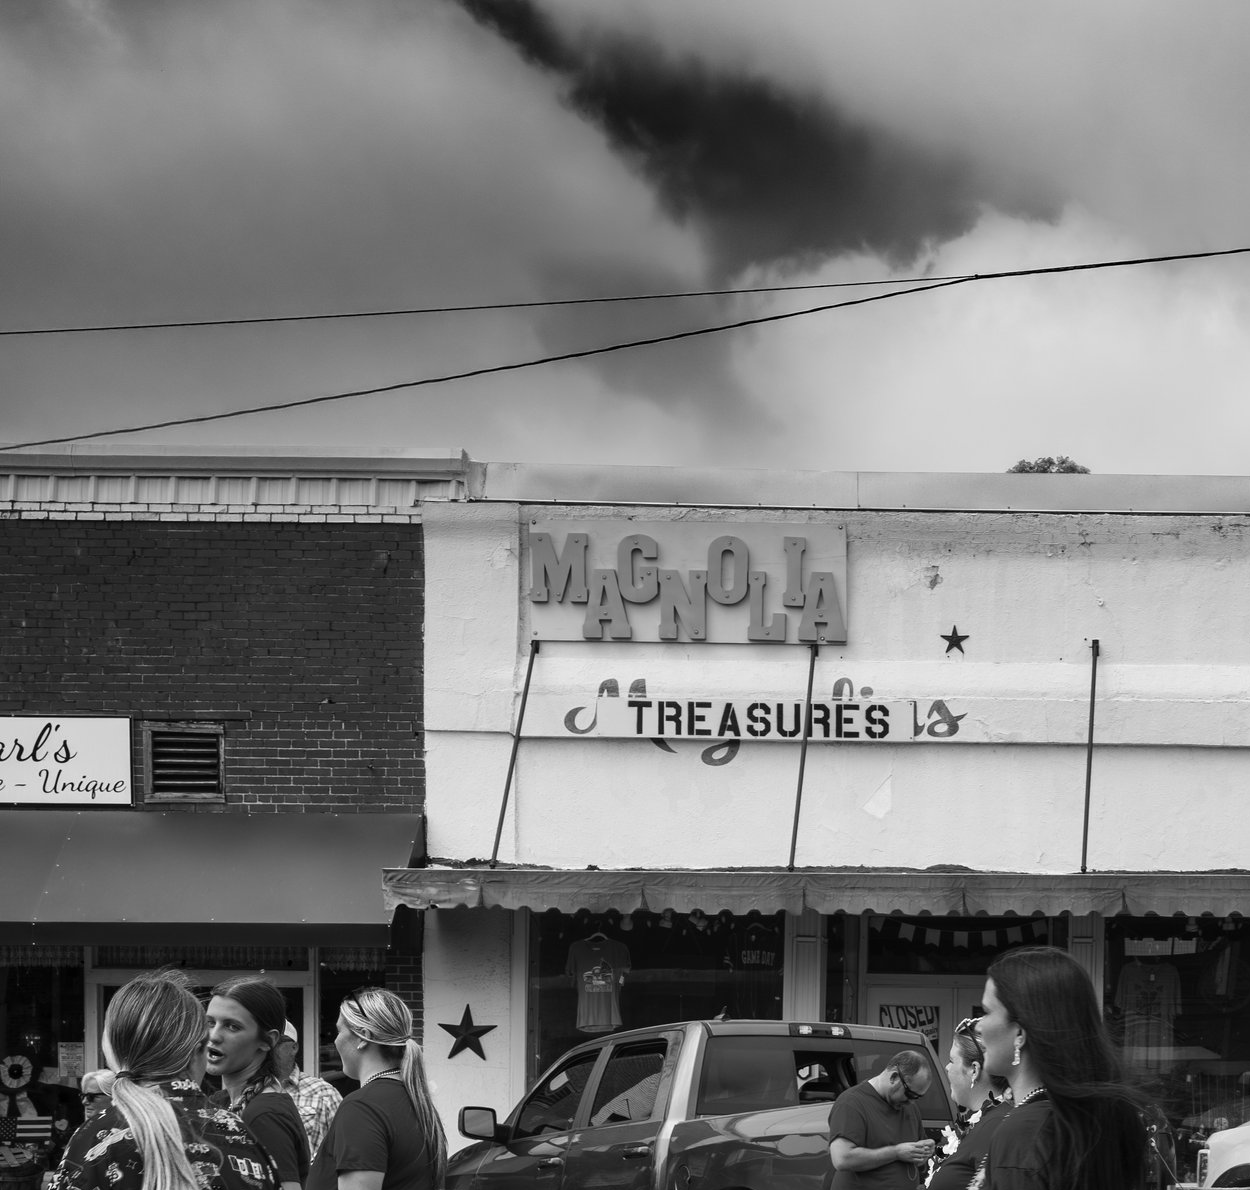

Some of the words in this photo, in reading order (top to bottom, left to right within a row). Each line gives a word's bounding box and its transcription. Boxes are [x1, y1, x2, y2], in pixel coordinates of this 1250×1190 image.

[529, 532, 847, 642] MAGNOLIA
[628, 701, 890, 739] TREASURES
[38, 768, 127, 800] Unique
[880, 1006, 935, 1030] CLOSED
